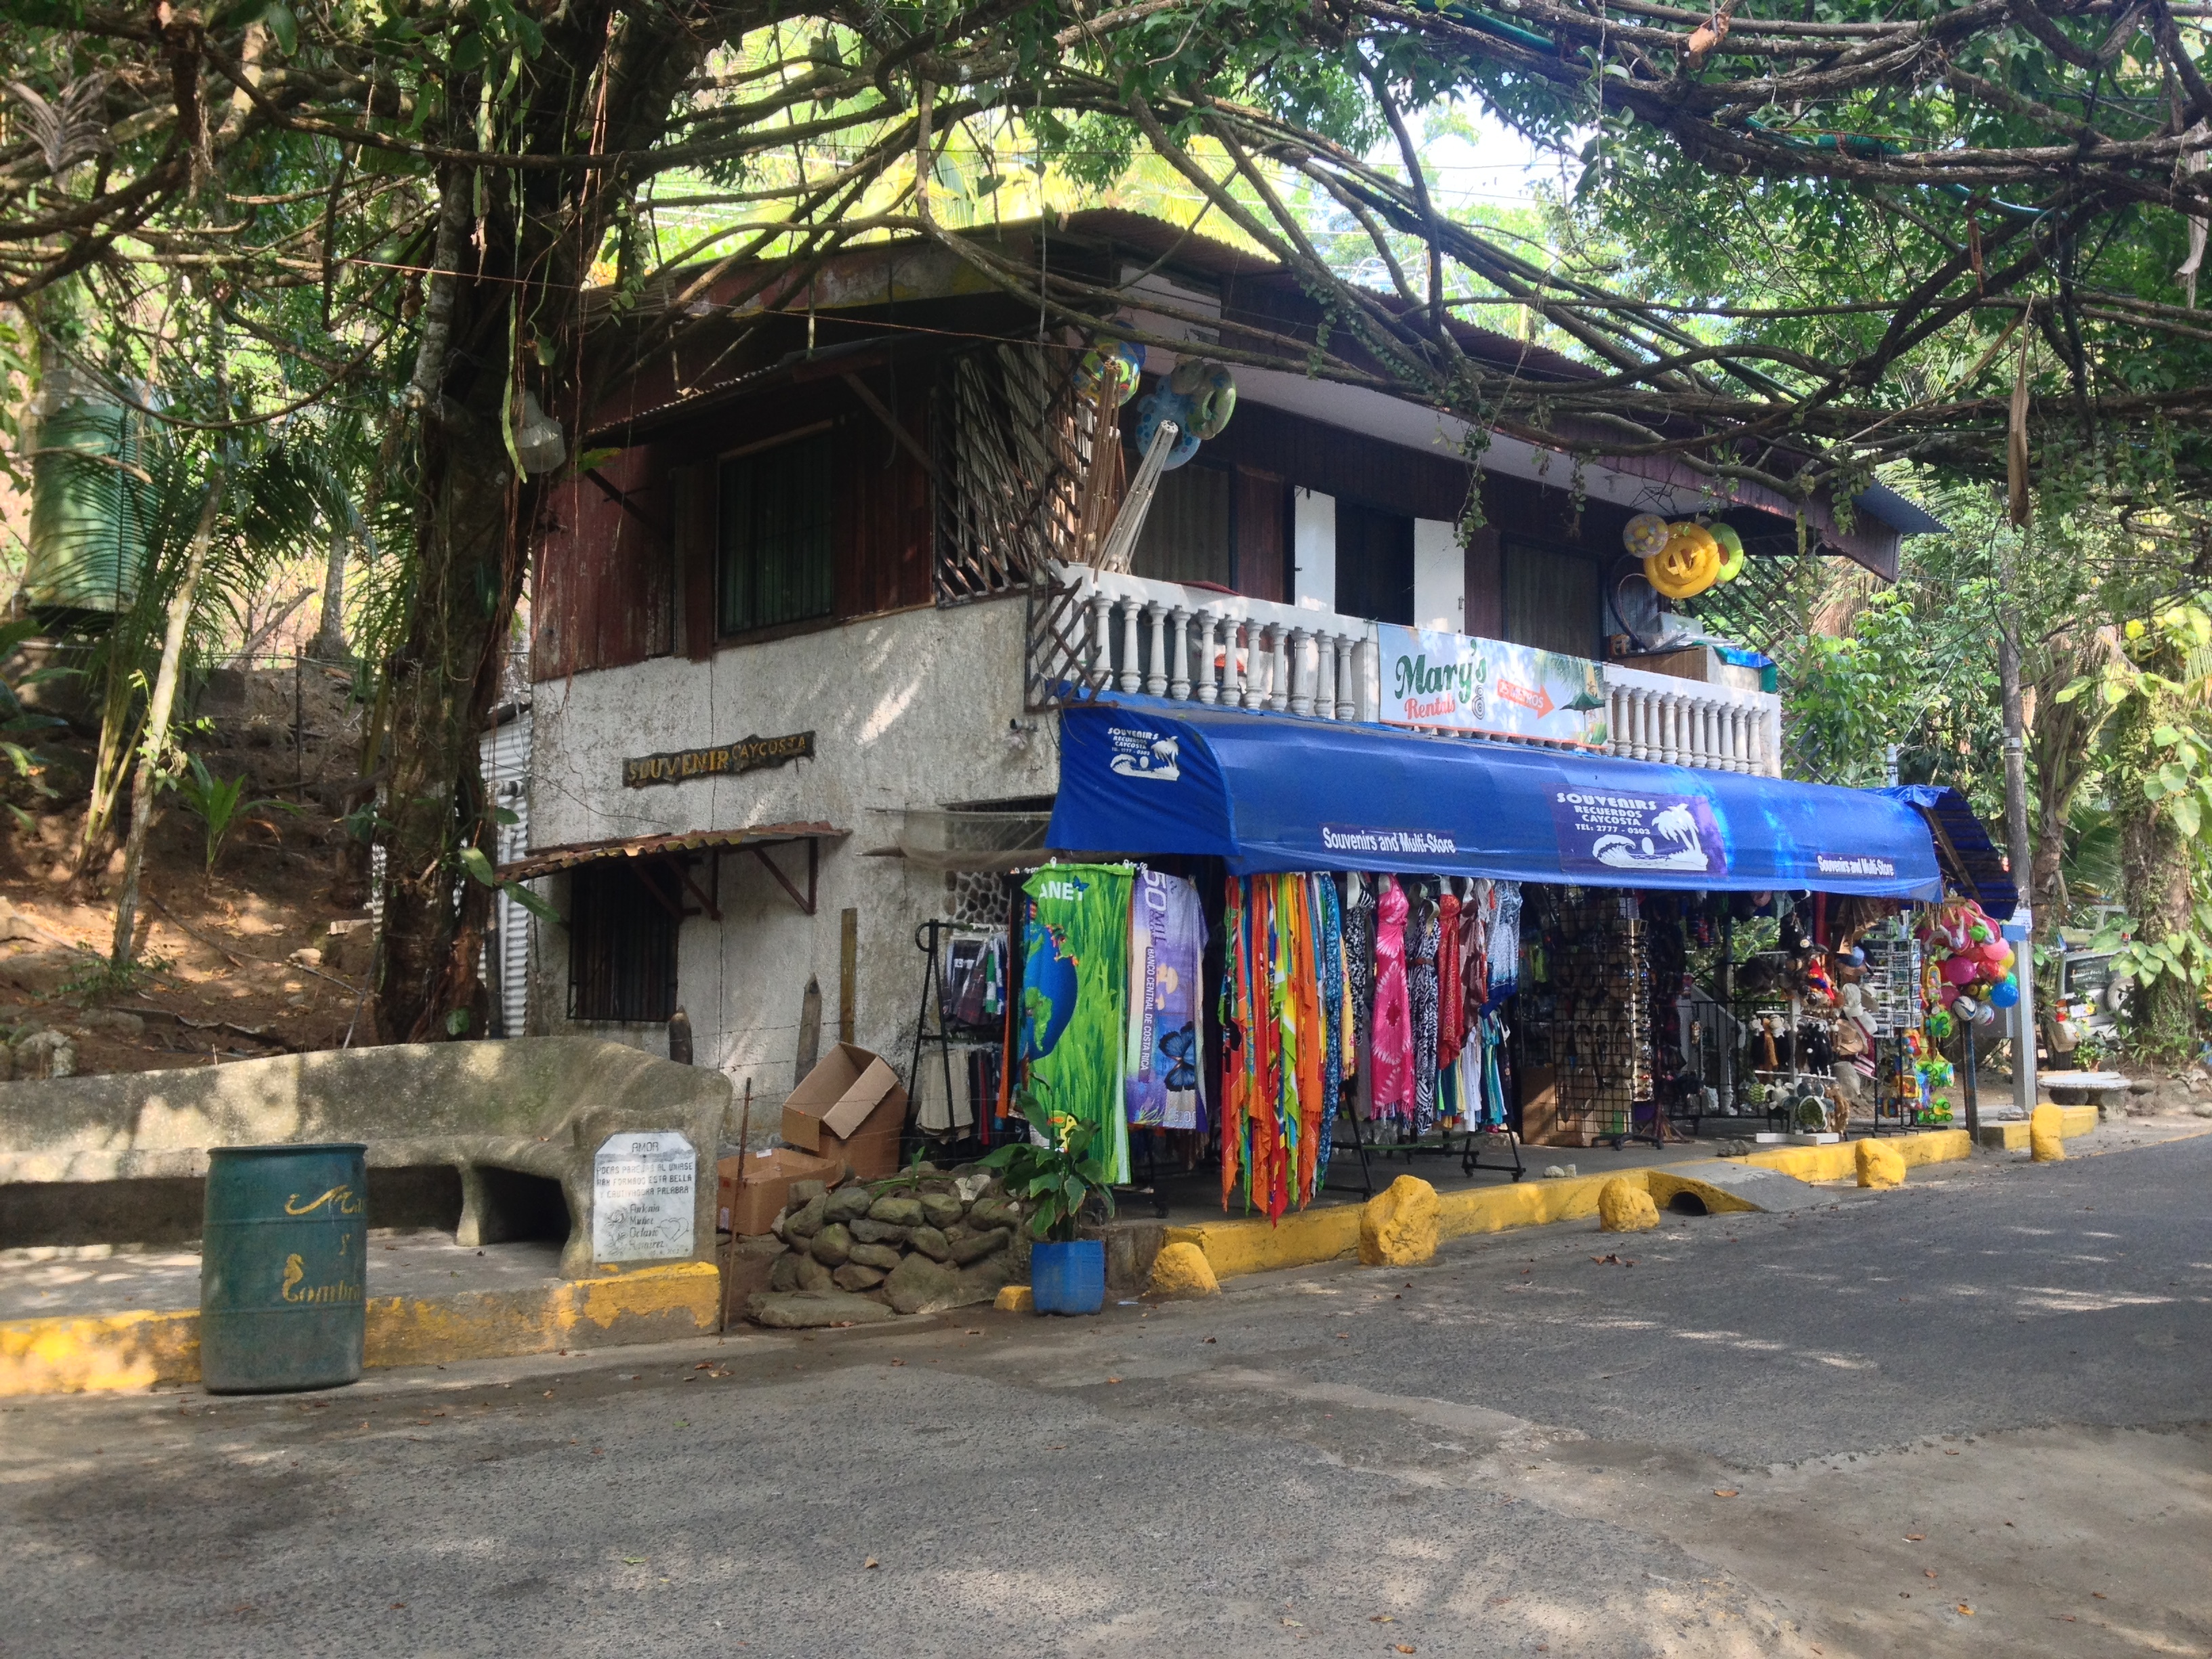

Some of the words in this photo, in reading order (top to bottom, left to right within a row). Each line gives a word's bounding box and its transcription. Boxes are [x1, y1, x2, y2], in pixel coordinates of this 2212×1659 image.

[1394, 639, 1487, 704] Mary's
[1511, 687, 1544, 708] METROS
[1404, 694, 1456, 720] Rentals
[1107, 727, 1159, 740] SOUVENIRS
[1113, 735, 1147, 745] RECUERDOS
[1115, 741, 1147, 750] CAYCOSTA
[628, 750, 729, 781] SOUVENIR
[731, 736, 806, 761] CAYCOSTA
[1557, 792, 1657, 811] SOUVENIRS
[1574, 805, 1643, 818] RECUERDOS
[1582, 814, 1641, 826] CAYCOSTA
[1596, 825, 1618, 833] 2777
[1322, 827, 1377, 851] Souvenirs
[1378, 832, 1399, 852] and
[1399, 832, 1456, 854] Multi-Store
[1817, 855, 1850, 873] Souvenirs
[1849, 858, 1862, 874] and
[1154, 911, 1166, 942] MIL
[1147, 949, 1155, 975] BANCO
[1145, 977, 1155, 1011] CENTRAL
[1144, 1013, 1153, 1024] DE
[1143, 1025, 1151, 1050] COSTA
[1141, 1052, 1150, 1070] RICA
[632, 1141, 659, 1153] AMOR
[613, 1176, 646, 1186] FORMADO
[649, 1174, 667, 1184] ESTA
[669, 1174, 692, 1183] BELLA
[657, 1185, 689, 1195] PALABRA
